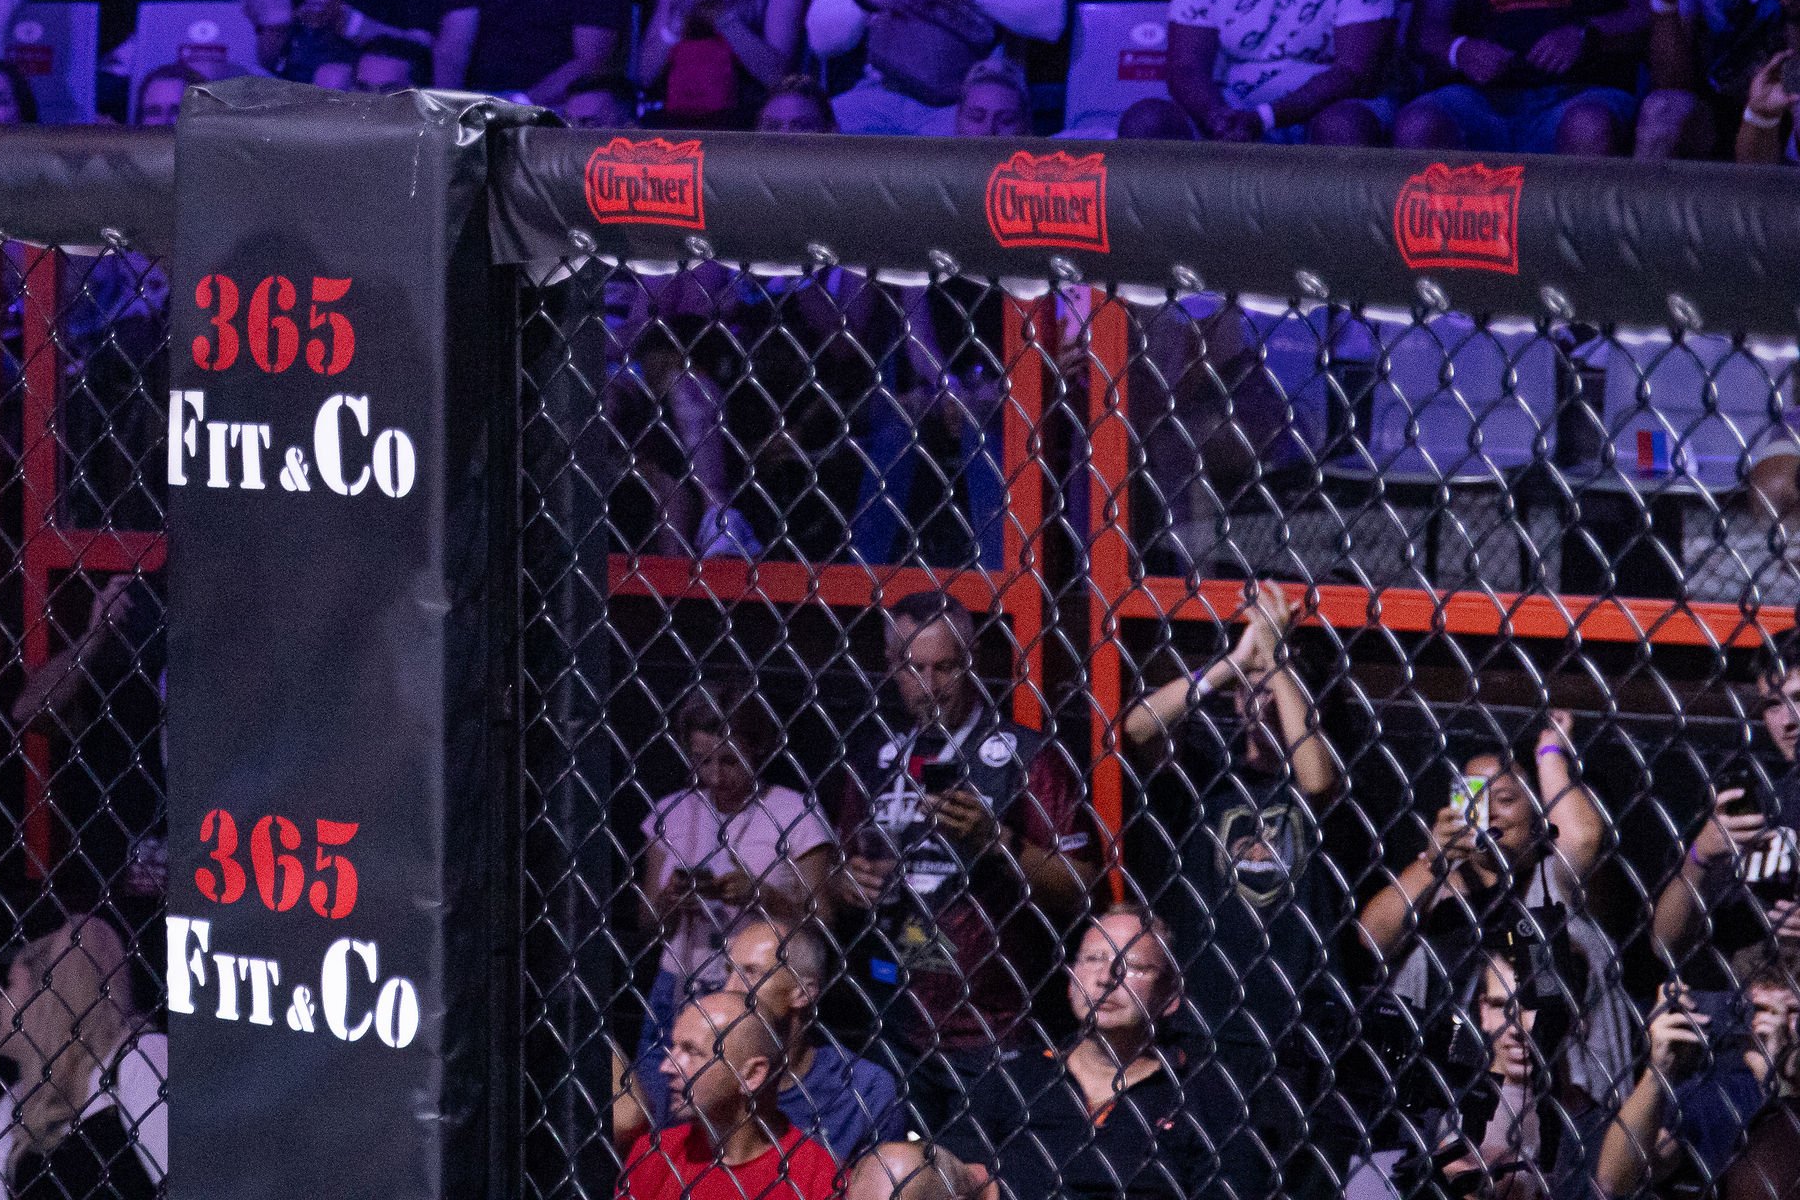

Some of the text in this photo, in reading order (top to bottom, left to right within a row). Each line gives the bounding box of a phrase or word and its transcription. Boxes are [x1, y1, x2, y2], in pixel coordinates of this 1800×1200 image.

[598, 165, 689, 212] Urpiner
[1001, 183, 1093, 233] Urpiner
[191, 273, 356, 377] 365
[194, 808, 360, 920] 365
